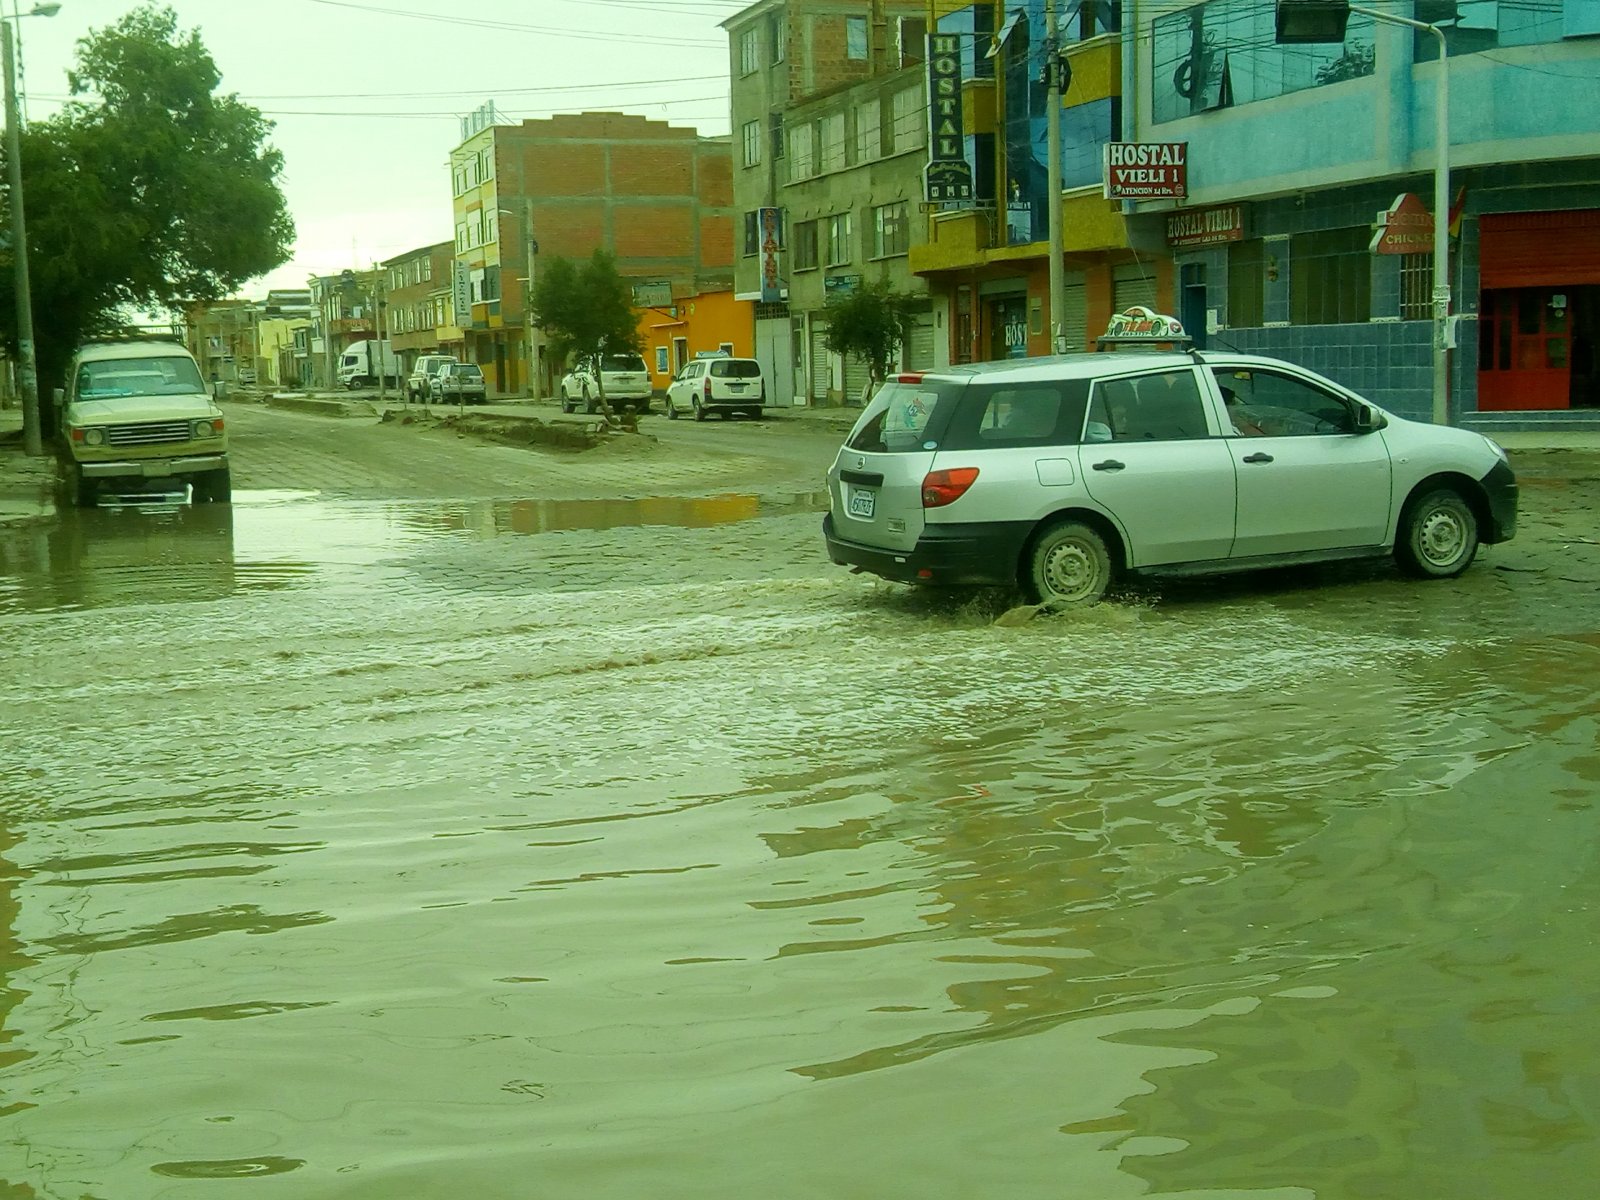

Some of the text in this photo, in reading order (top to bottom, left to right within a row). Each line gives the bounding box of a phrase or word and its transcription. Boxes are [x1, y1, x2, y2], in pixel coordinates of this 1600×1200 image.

[933, 37, 958, 156] HOSTAL
[1110, 145, 1184, 166] HOSTAL
[1116, 169, 1179, 183] VIELI 1
[1121, 187, 1153, 195] ATENCION
[1167, 207, 1241, 238] HOSTAL VIELI 1
